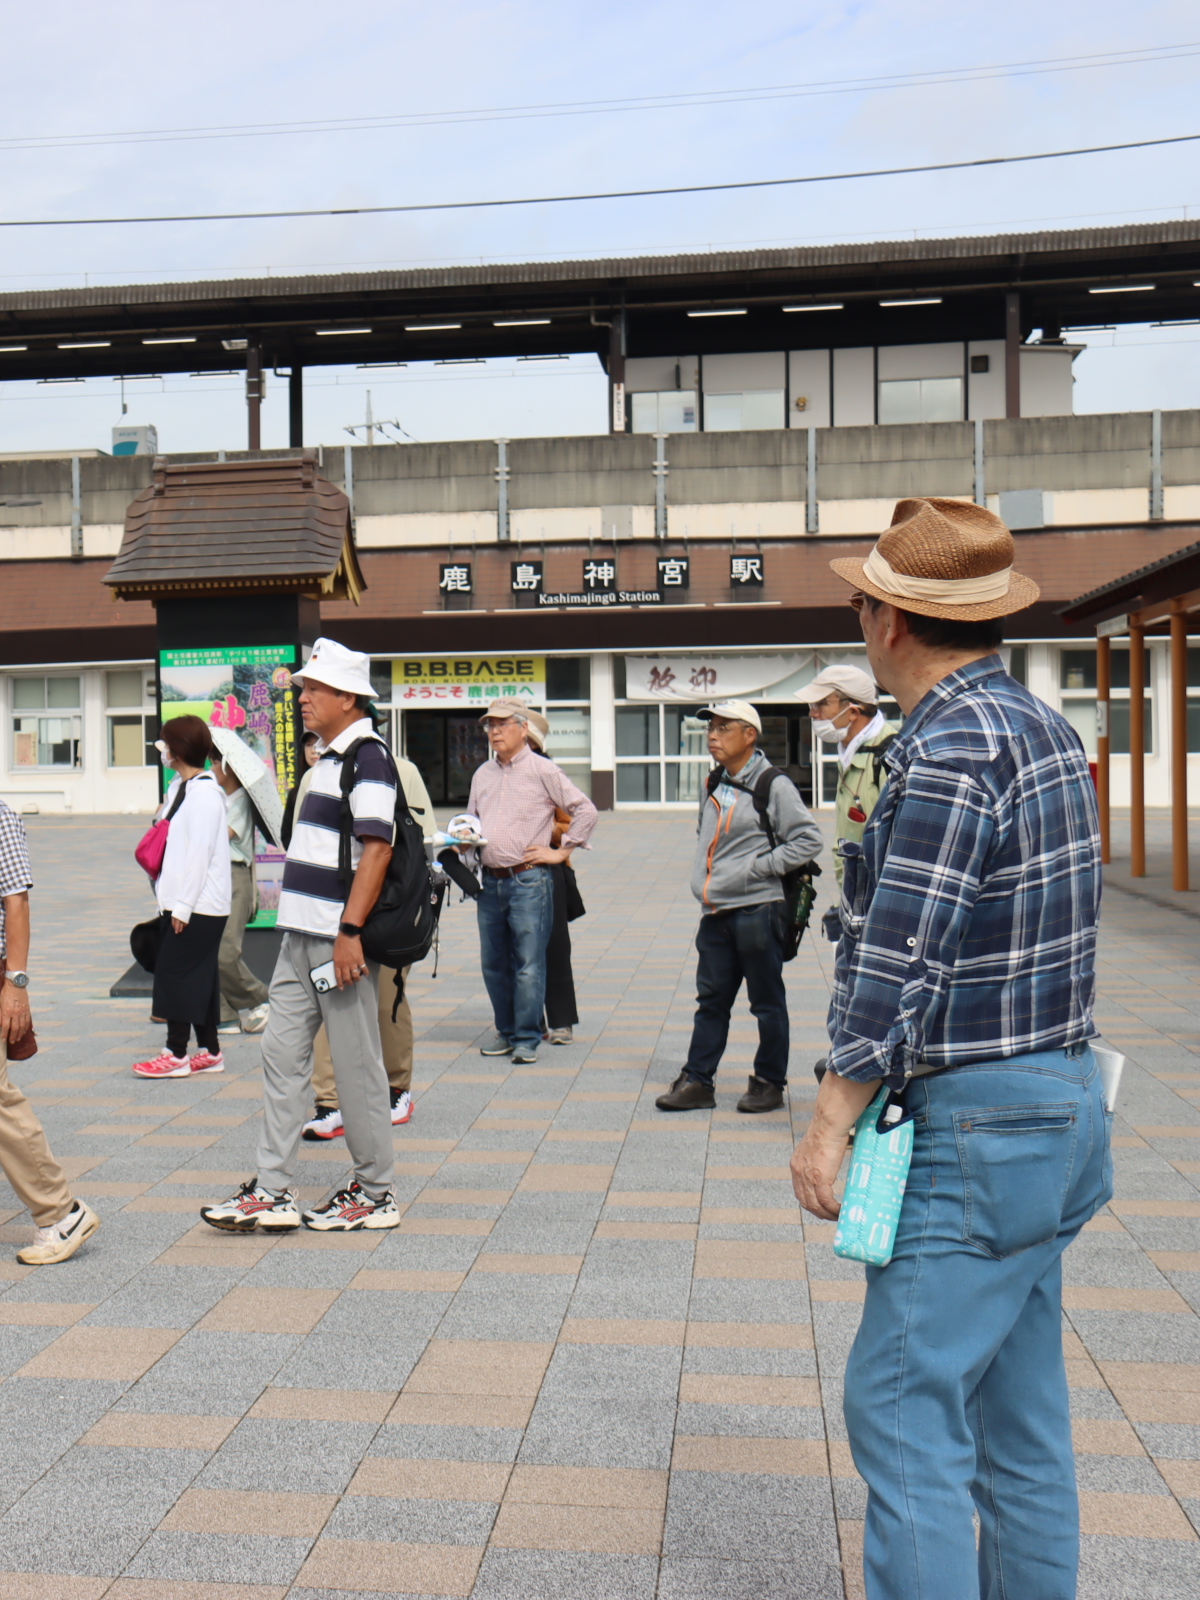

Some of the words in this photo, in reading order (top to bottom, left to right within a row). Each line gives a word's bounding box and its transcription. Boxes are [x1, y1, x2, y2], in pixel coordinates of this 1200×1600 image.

[439, 558, 763, 591] 鹿島神宮駅
[539, 591, 617, 604] Kashimajingū
[619, 591, 660, 602] Station
[403, 660, 535, 677] B.B.BASE
[403, 685, 463, 698] ようこそ
